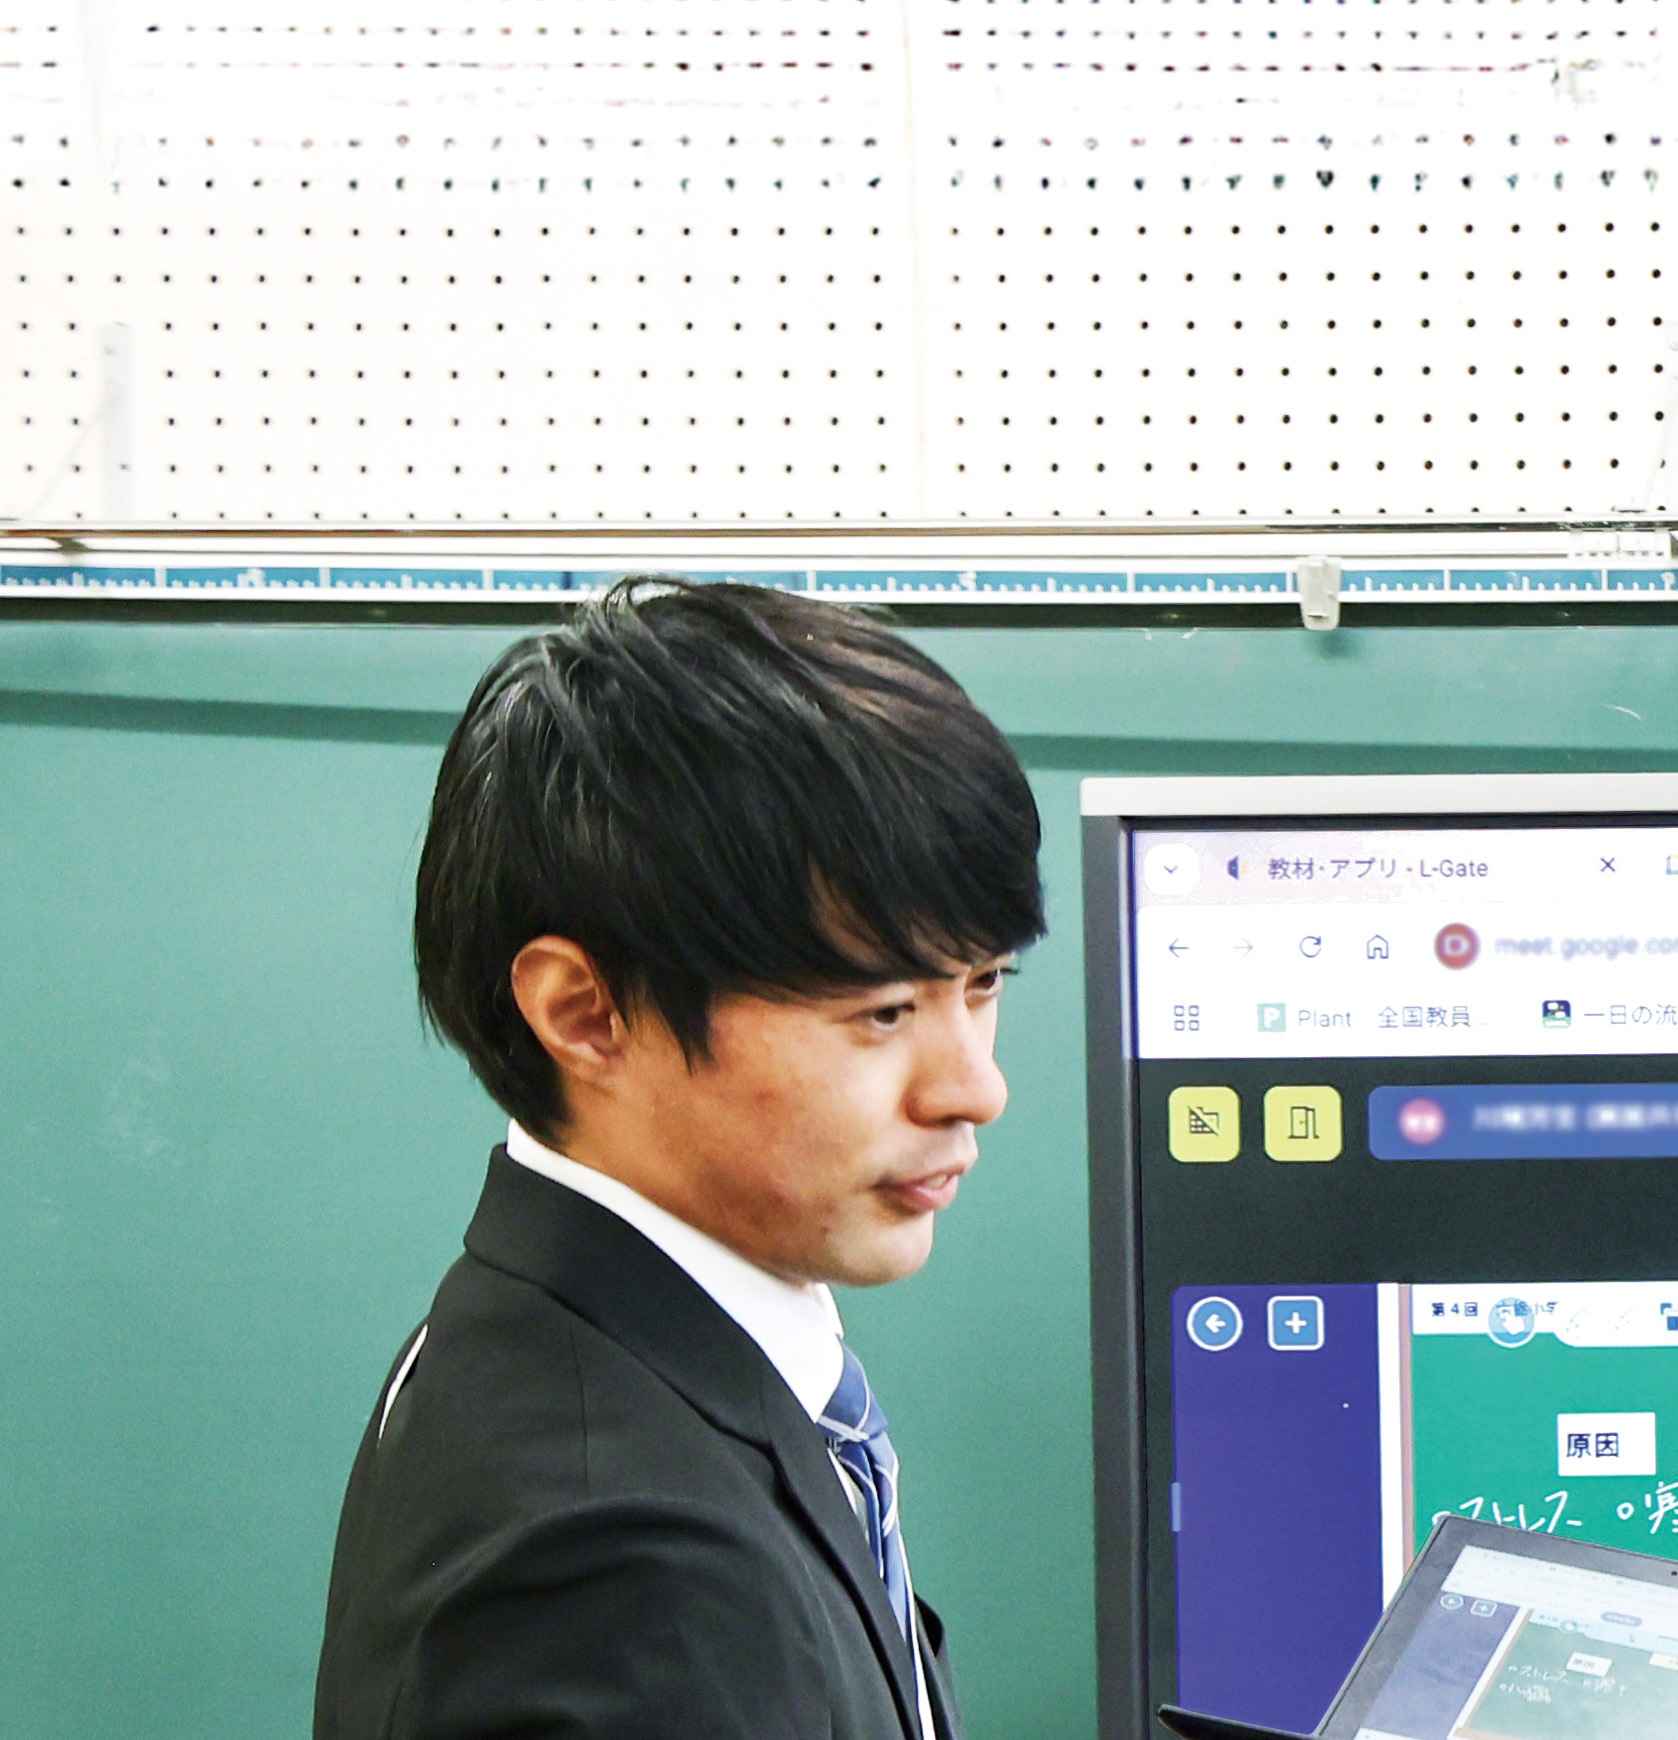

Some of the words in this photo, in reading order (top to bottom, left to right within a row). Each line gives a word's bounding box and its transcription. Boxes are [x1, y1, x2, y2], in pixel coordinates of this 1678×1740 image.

[1418, 857, 1490, 879] L-Gate
[1297, 1008, 1353, 1029] Plant
[1565, 1432, 1620, 1459] 原因
